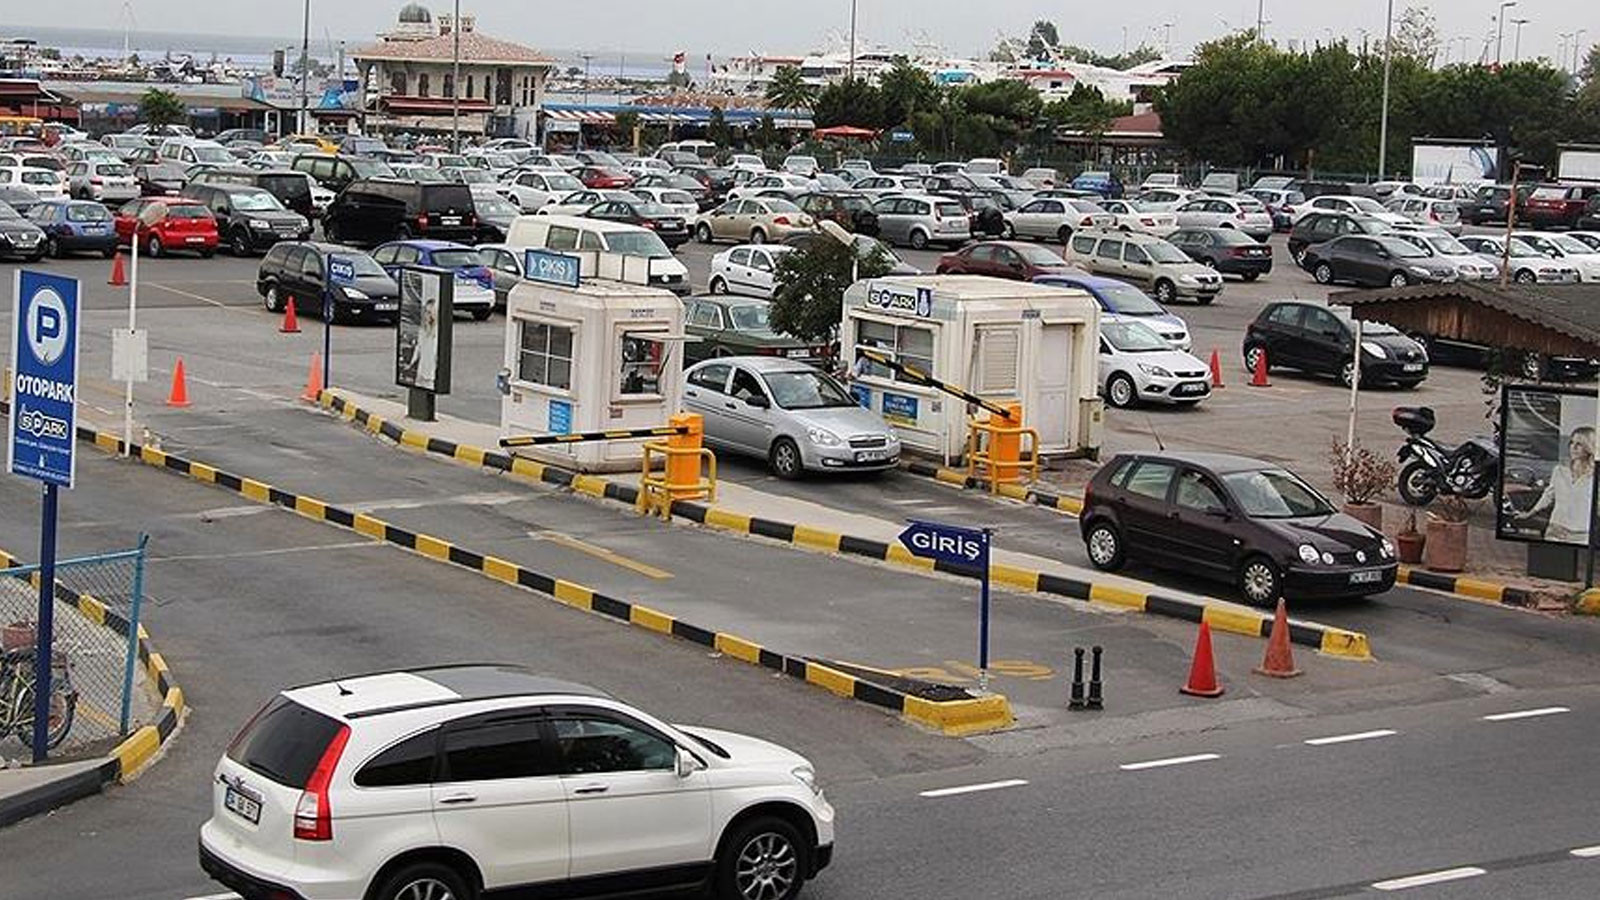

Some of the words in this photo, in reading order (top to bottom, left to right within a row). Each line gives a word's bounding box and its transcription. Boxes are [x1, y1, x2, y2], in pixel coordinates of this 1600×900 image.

[36, 305, 61, 344] P
[17, 373, 74, 403] OTOPARK
[911, 531, 980, 560] GİRİŞ
